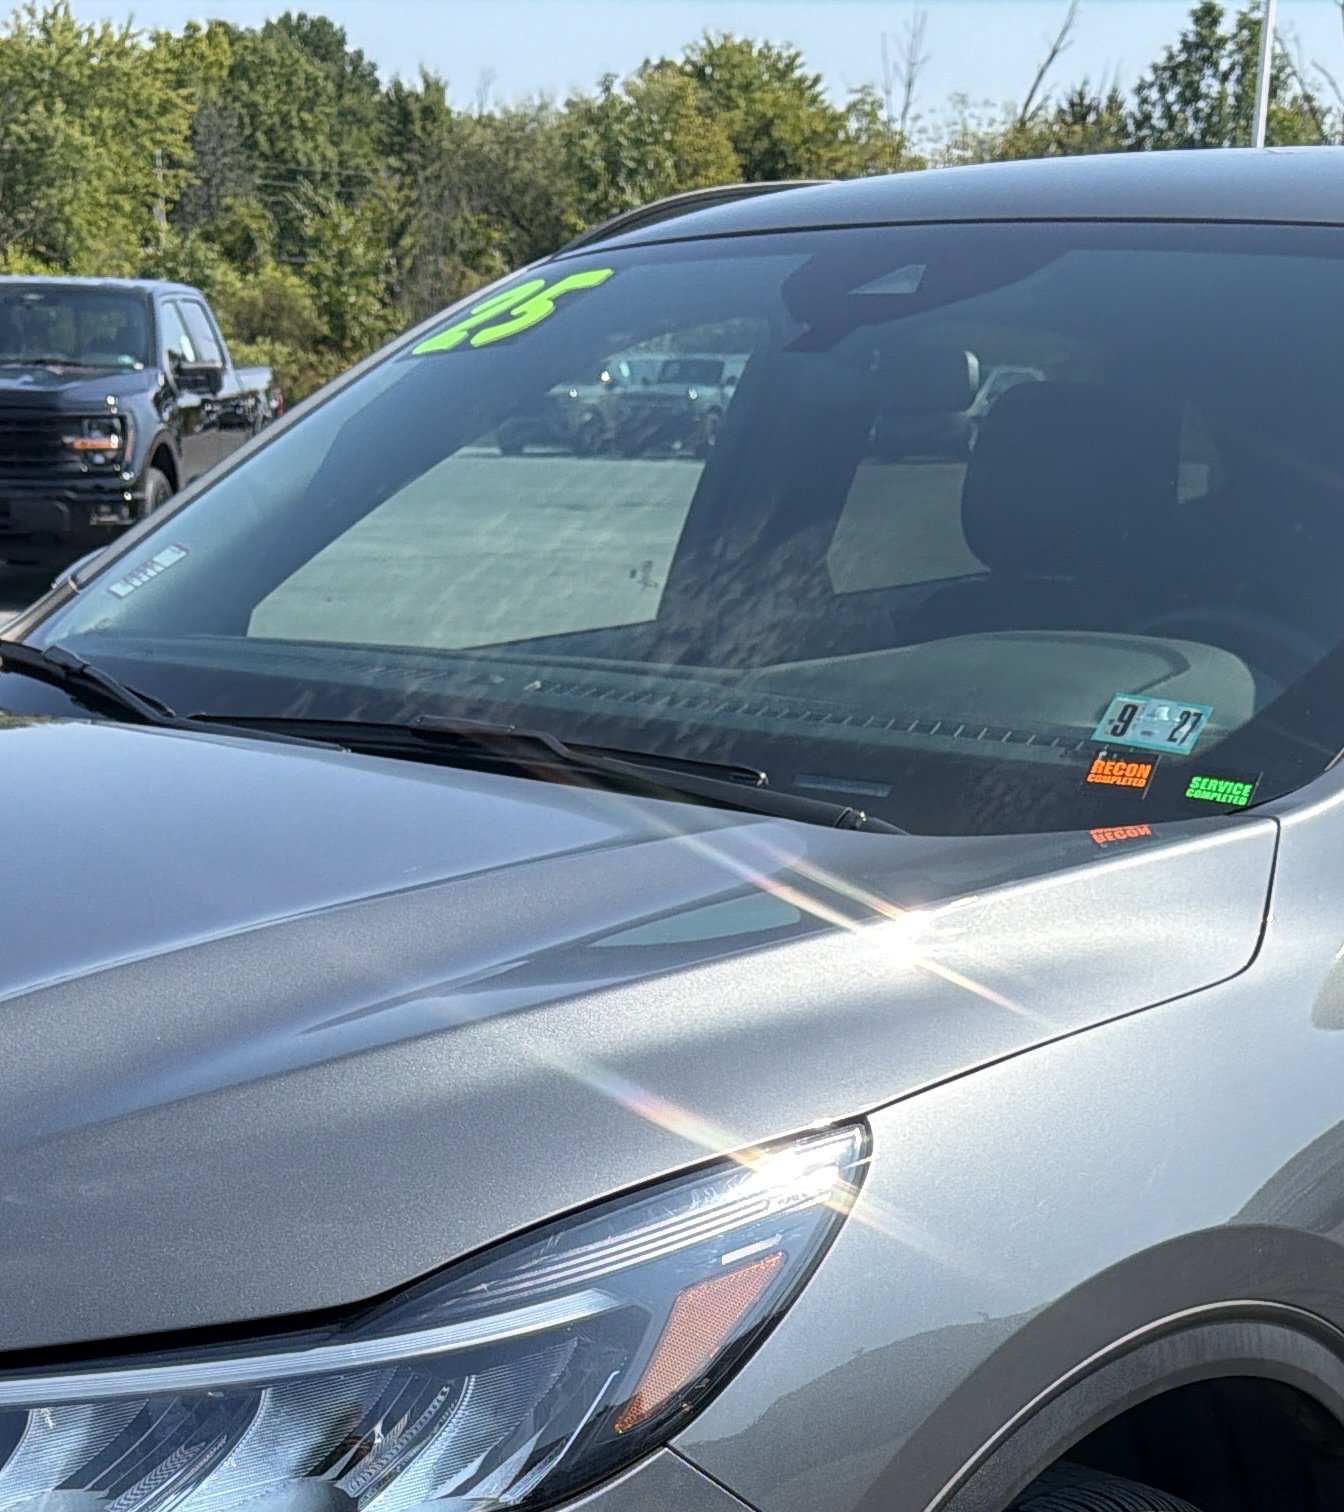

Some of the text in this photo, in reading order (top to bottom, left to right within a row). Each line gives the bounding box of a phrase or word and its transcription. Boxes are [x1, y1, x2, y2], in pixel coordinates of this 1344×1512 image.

[412, 268, 615, 355] 25
[1110, 703, 1203, 746] 9 27
[1090, 759, 1152, 779] RECON
[1086, 773, 1147, 788] COMPLETED
[1189, 776, 1253, 798] SERVICE
[1185, 788, 1248, 806] COMPLETED
